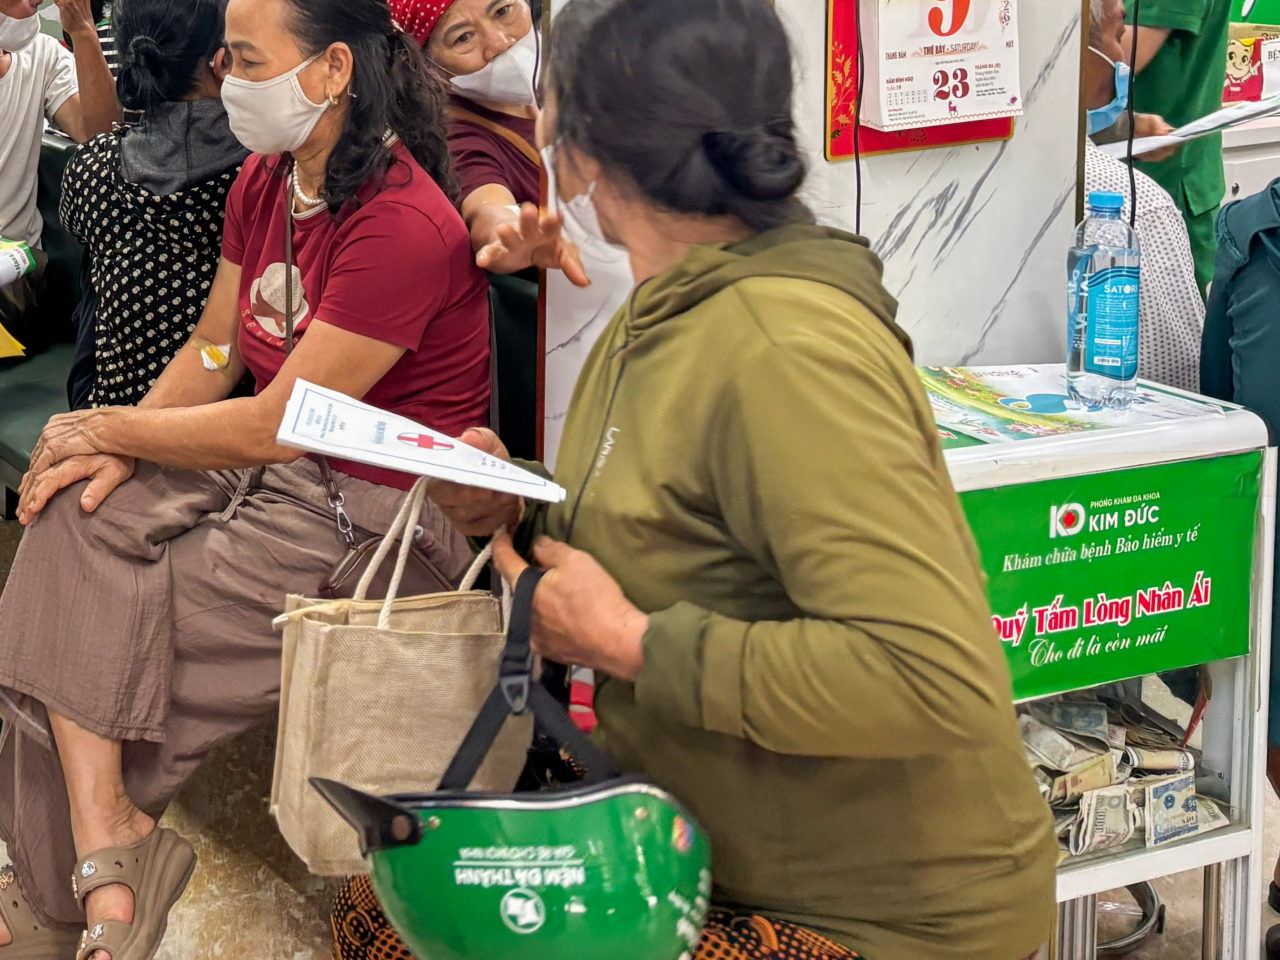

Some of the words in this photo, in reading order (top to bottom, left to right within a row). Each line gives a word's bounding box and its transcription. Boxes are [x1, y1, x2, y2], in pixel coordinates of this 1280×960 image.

[923, 45, 935, 56] THỨ
[935, 43, 946, 54] BẢY
[950, 42, 977, 53] SATURDAY
[932, 68, 970, 101] 23
[1103, 284, 1138, 294] SATORI
[1090, 497, 1113, 509] PHÒNG
[1113, 494, 1132, 506] KHÁM
[1142, 491, 1161, 501] KHOA
[1089, 511, 1119, 533] KIM
[1124, 502, 1160, 527] ĐỨC
[1002, 554, 1042, 572] Khám
[1045, 547, 1077, 565] chữa
[1080, 542, 1112, 563] bệnh
[1115, 534, 1139, 554] Bảo
[1142, 527, 1173, 550] hiểm
[1174, 534, 1184, 548] y
[1186, 523, 1201, 543] tế
[1032, 594, 1079, 636] Tấm
[1083, 592, 1132, 626] Lòng
[1136, 581, 1184, 618] Nhân
[1186, 570, 1212, 609] Ái
[1028, 638, 1063, 667] Cho
[1067, 637, 1084, 660] đi
[1086, 635, 1102, 656] là
[1105, 633, 1131, 653] còn
[1135, 624, 1169, 648] mãi
